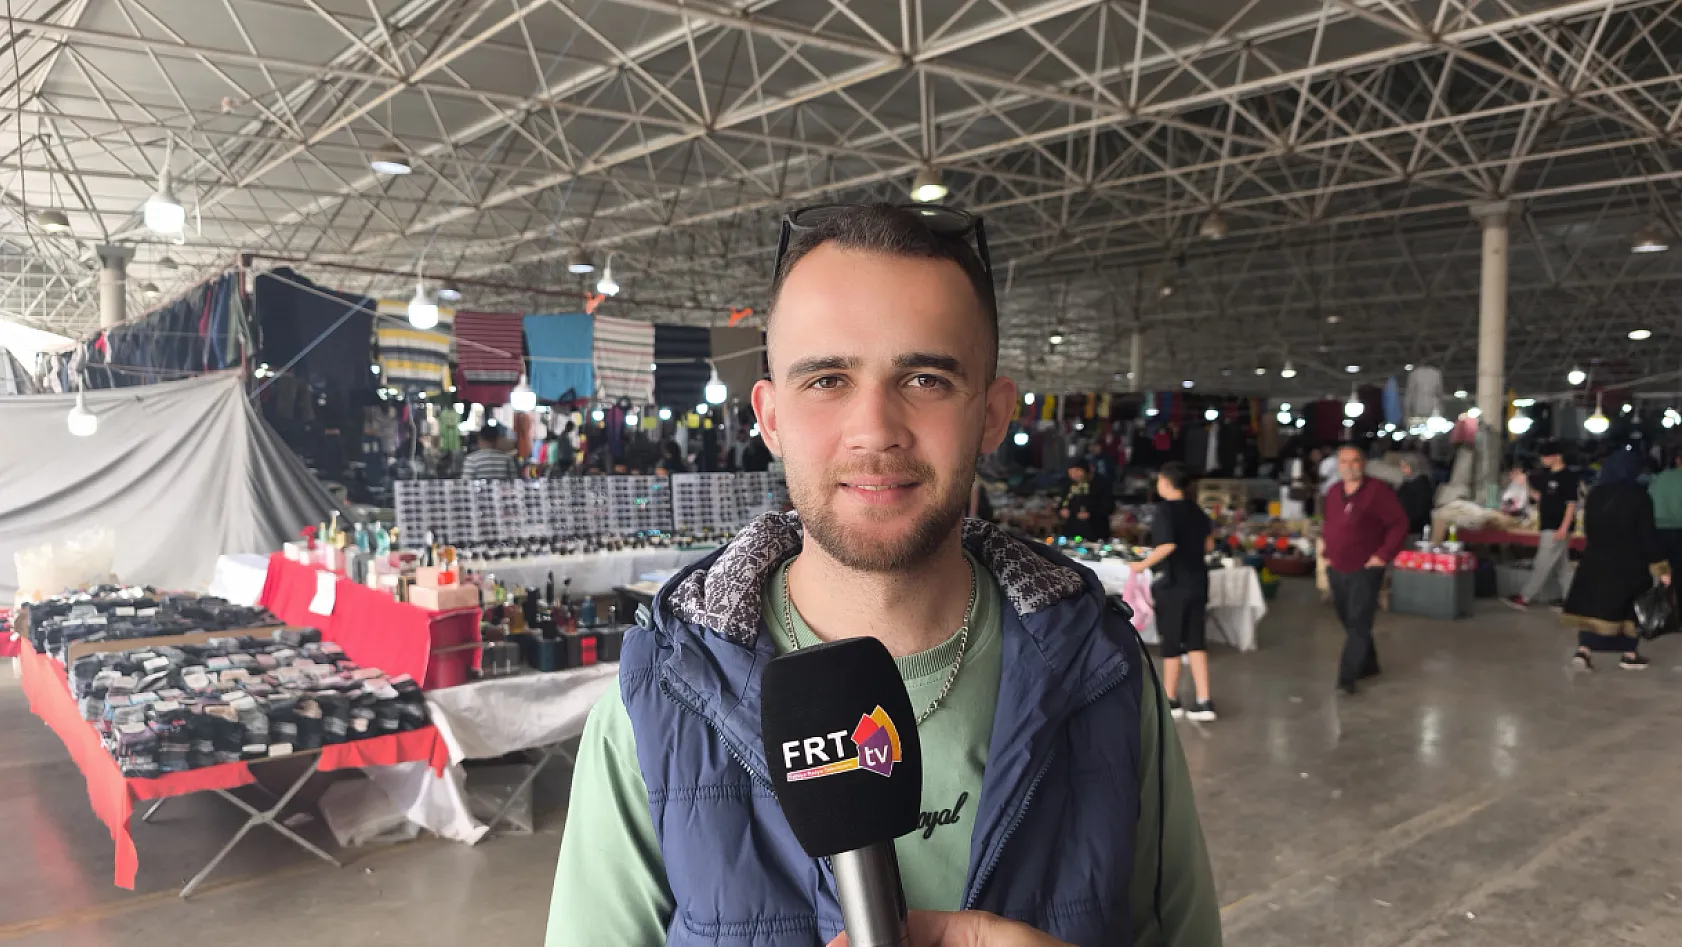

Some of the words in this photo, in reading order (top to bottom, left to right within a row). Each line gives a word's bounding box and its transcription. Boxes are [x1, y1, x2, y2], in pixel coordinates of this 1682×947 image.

[782, 730, 848, 768] FRT
[864, 745, 888, 766] tv
[917, 791, 968, 839] oyal
